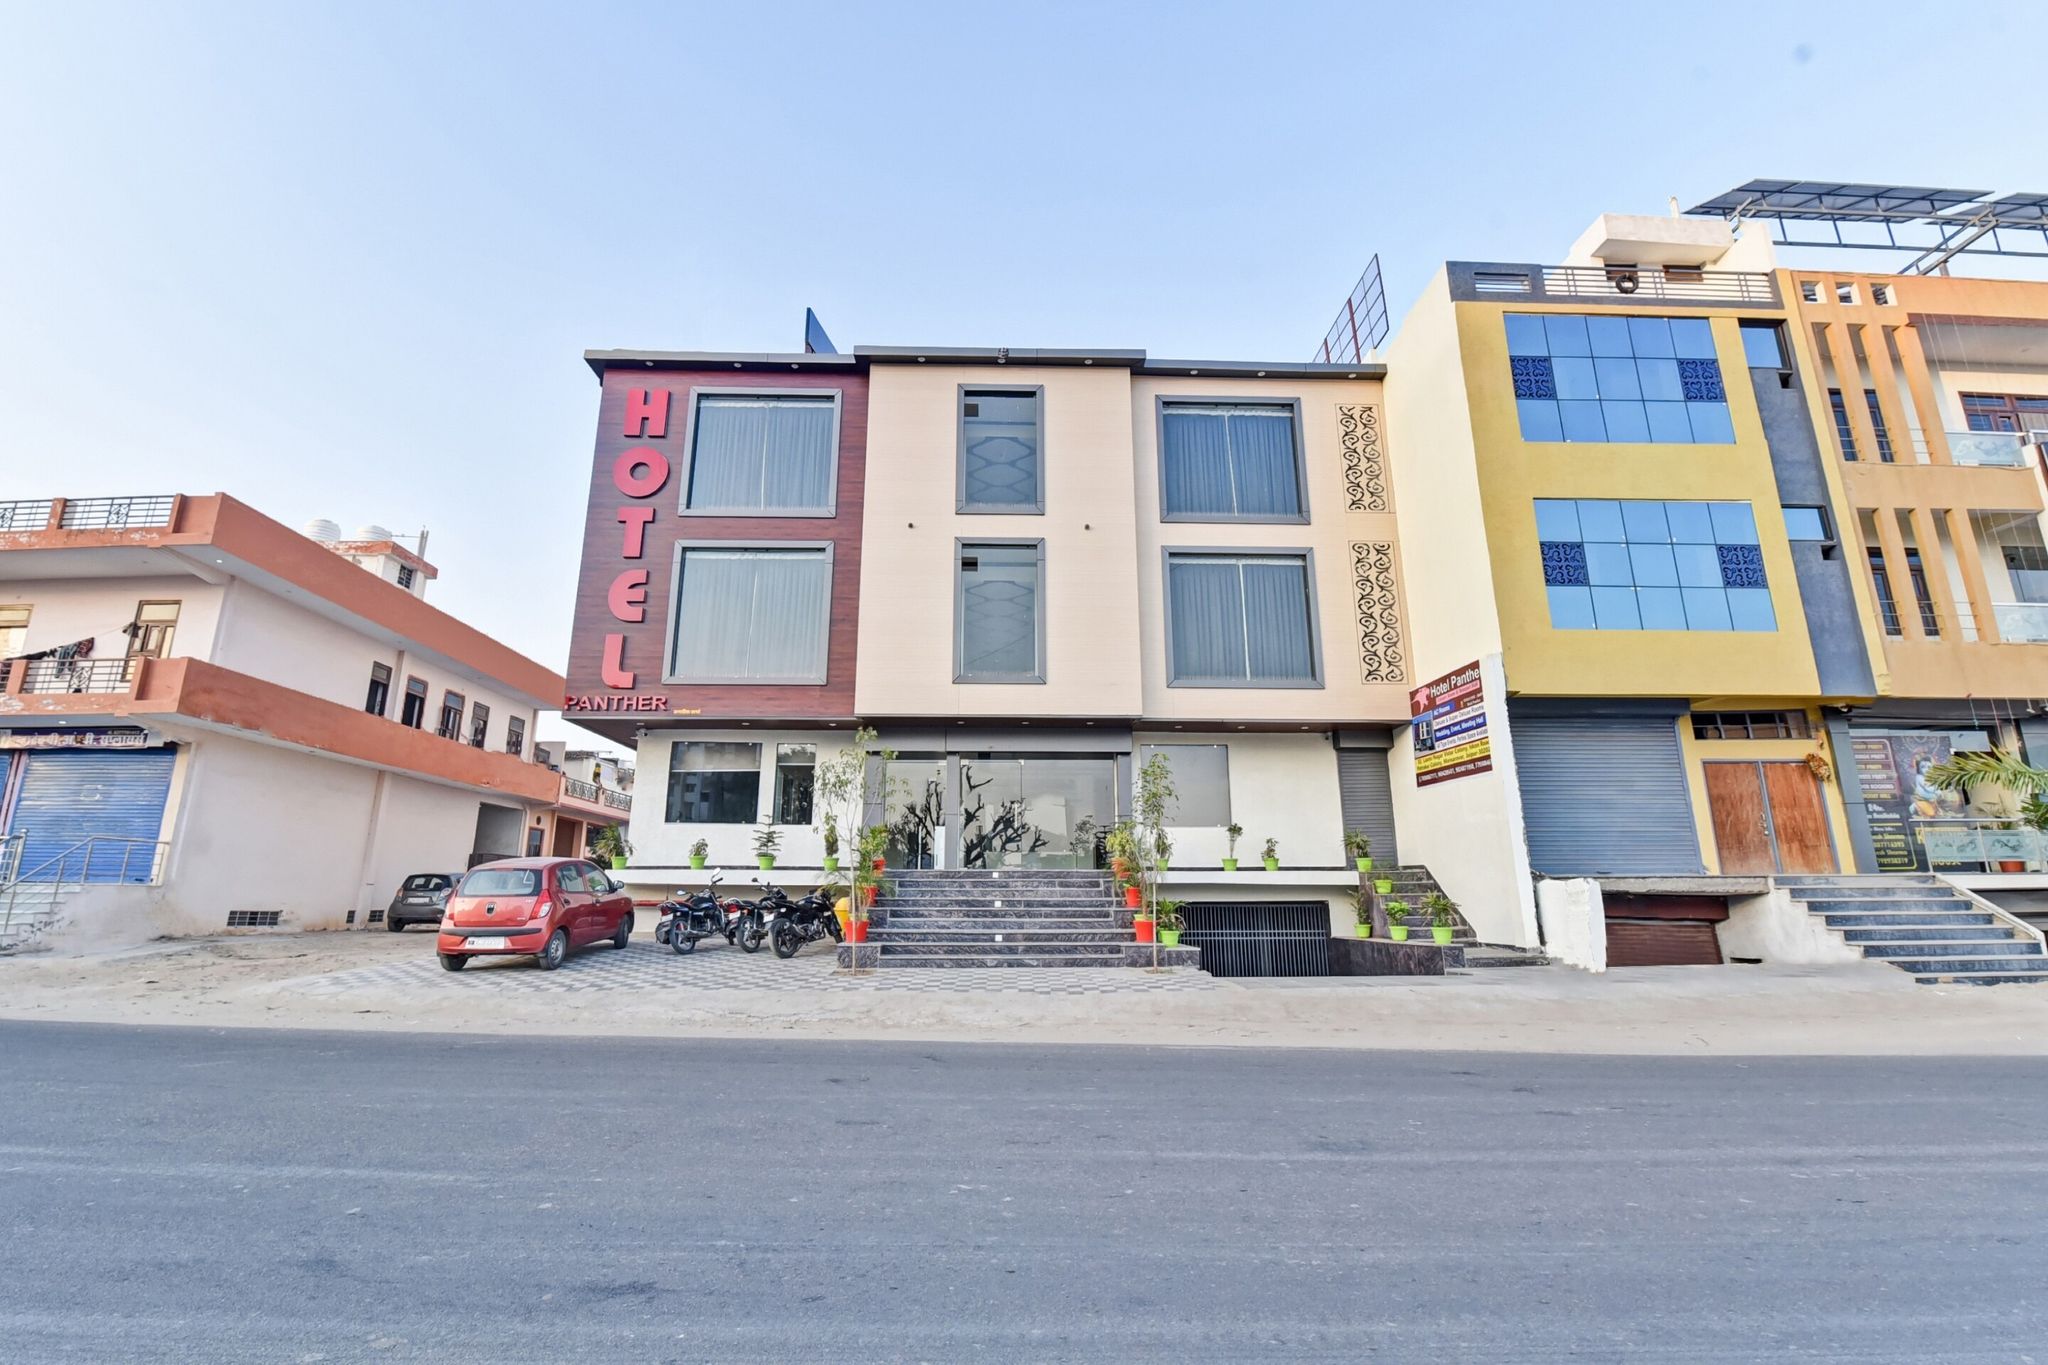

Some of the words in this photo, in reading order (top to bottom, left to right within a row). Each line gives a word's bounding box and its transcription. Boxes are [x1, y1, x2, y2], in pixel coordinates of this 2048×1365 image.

[602, 390, 669, 688] HOTEL
[1430, 679, 1450, 698] Hotel
[564, 695, 669, 711] PANTHER
